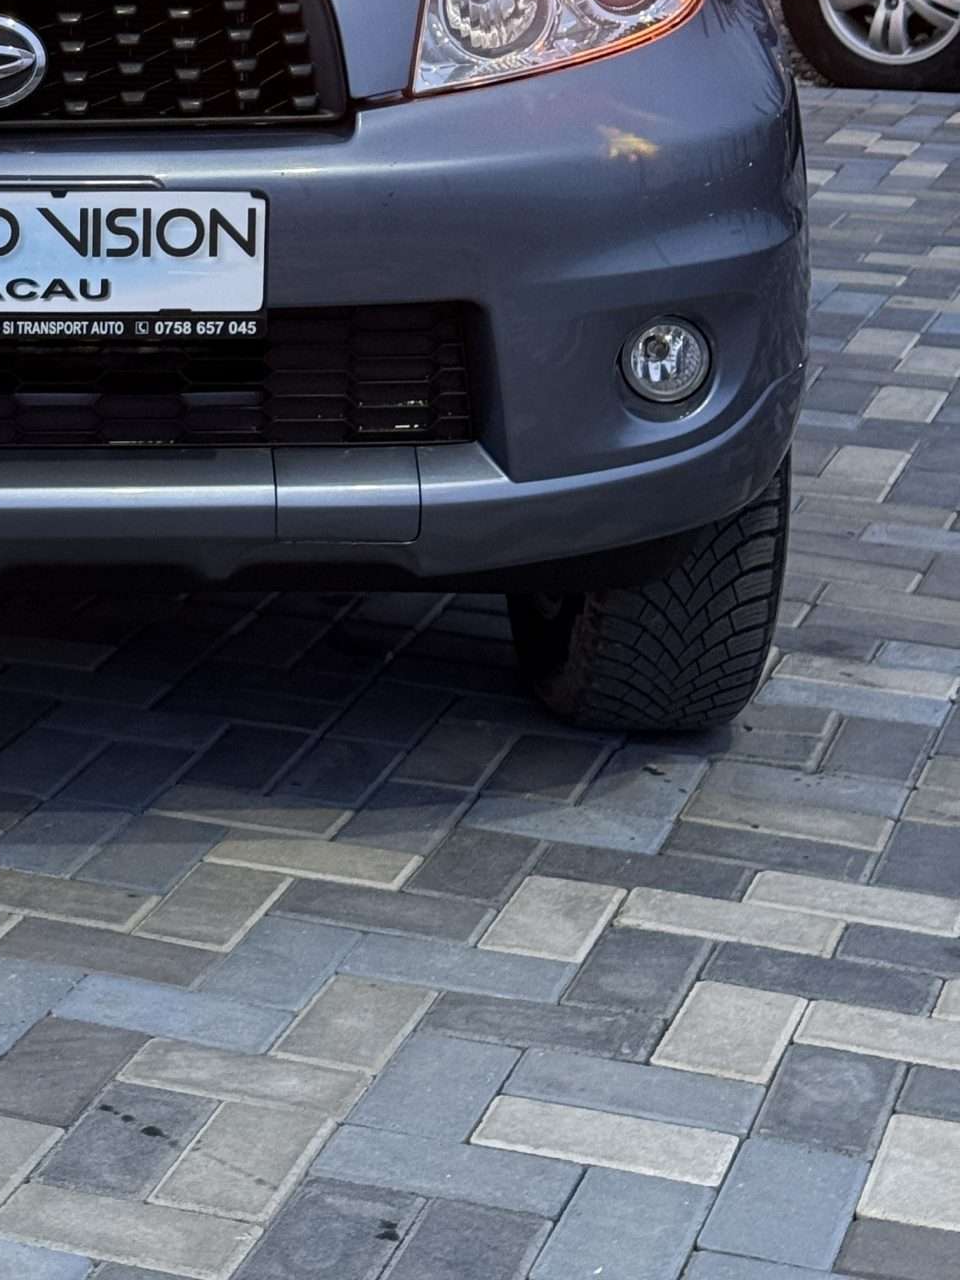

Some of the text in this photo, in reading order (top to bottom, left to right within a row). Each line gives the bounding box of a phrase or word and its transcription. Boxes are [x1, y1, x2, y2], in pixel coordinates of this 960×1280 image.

[36, 207, 257, 257] VISION
[2, 321, 15, 335] SI
[17, 321, 88, 335] TRANSPORT
[90, 321, 124, 335] AUTO
[154, 321, 191, 335] 0758
[196, 321, 224, 335] 657
[228, 321, 257, 335] 045
